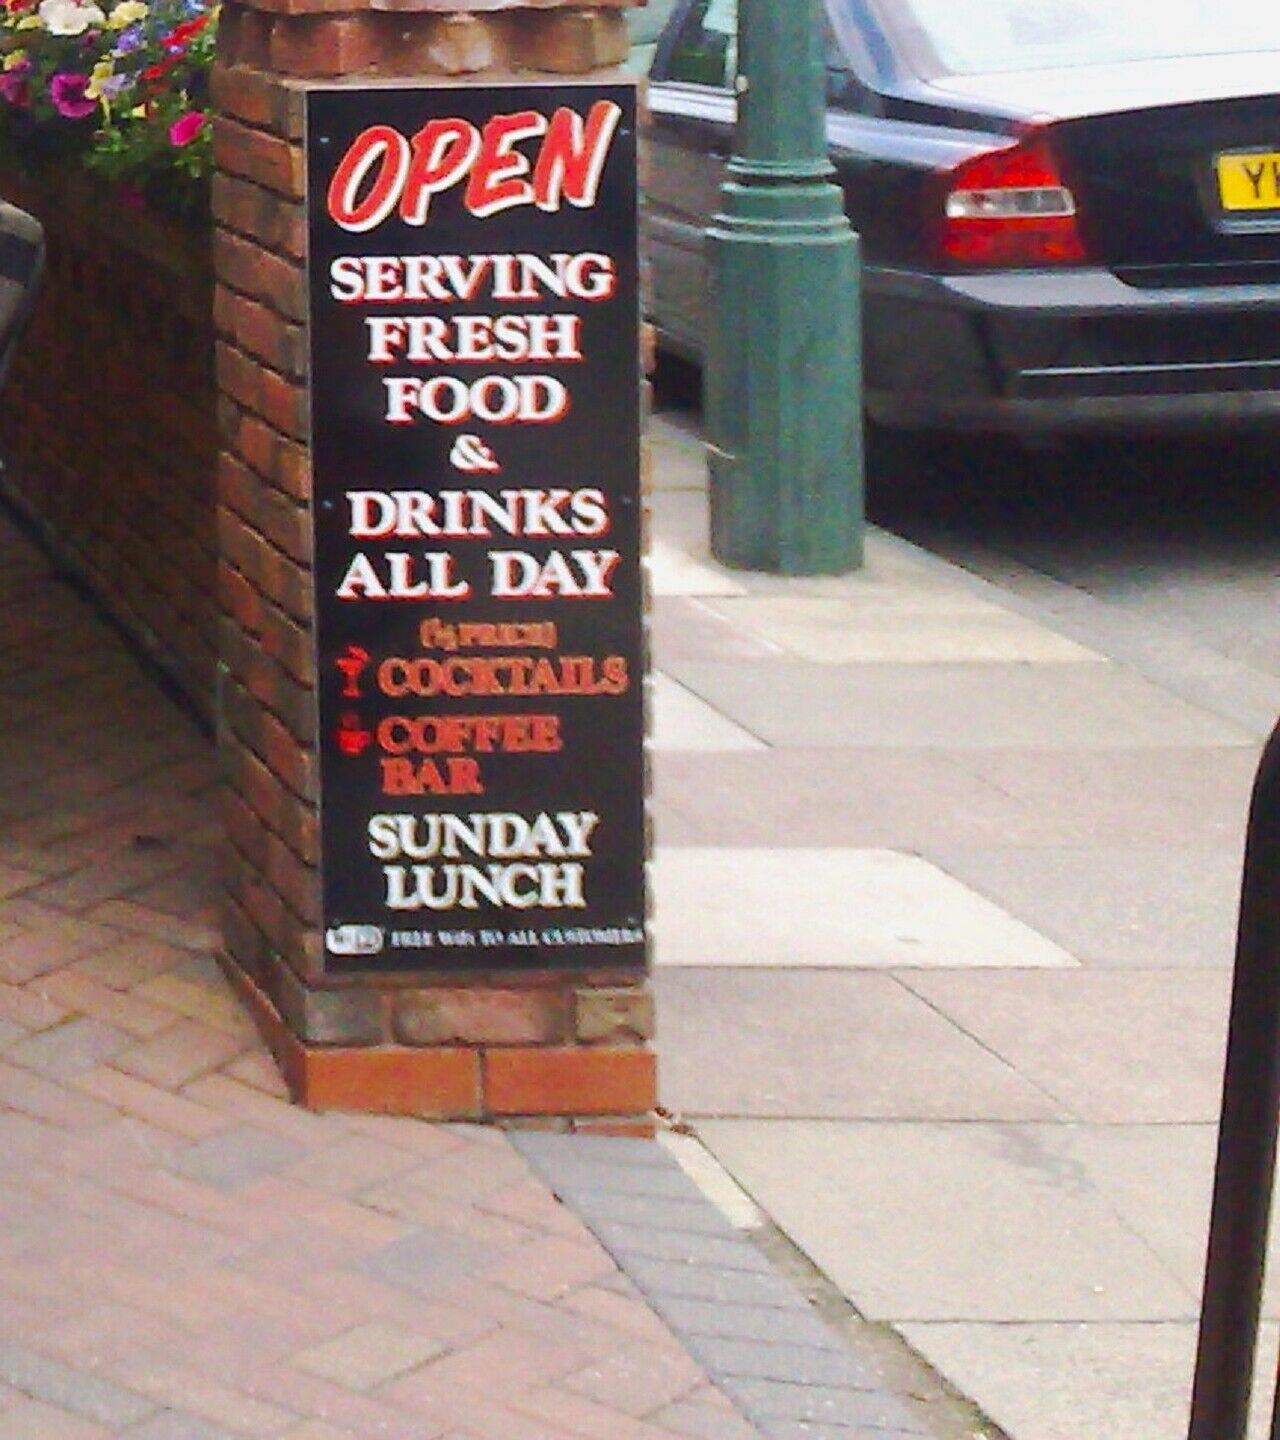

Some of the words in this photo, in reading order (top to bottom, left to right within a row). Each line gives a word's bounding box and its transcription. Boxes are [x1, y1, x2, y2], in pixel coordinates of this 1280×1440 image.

[327, 99, 622, 233] OPEN
[329, 252, 619, 301] SERVING
[364, 313, 584, 364] FRESH
[382, 374, 573, 425] FOOD
[449, 433, 502, 474] &
[345, 488, 611, 540] DRINKS
[335, 551, 472, 601] ALL
[488, 549, 624, 600] DAY
[376, 656, 629, 698] COCKTAILS
[377, 715, 564, 754] COFFEE
[380, 757, 485, 796] BAR
[367, 812, 600, 860] SUNDAY
[383, 862, 587, 910] LUNCH
